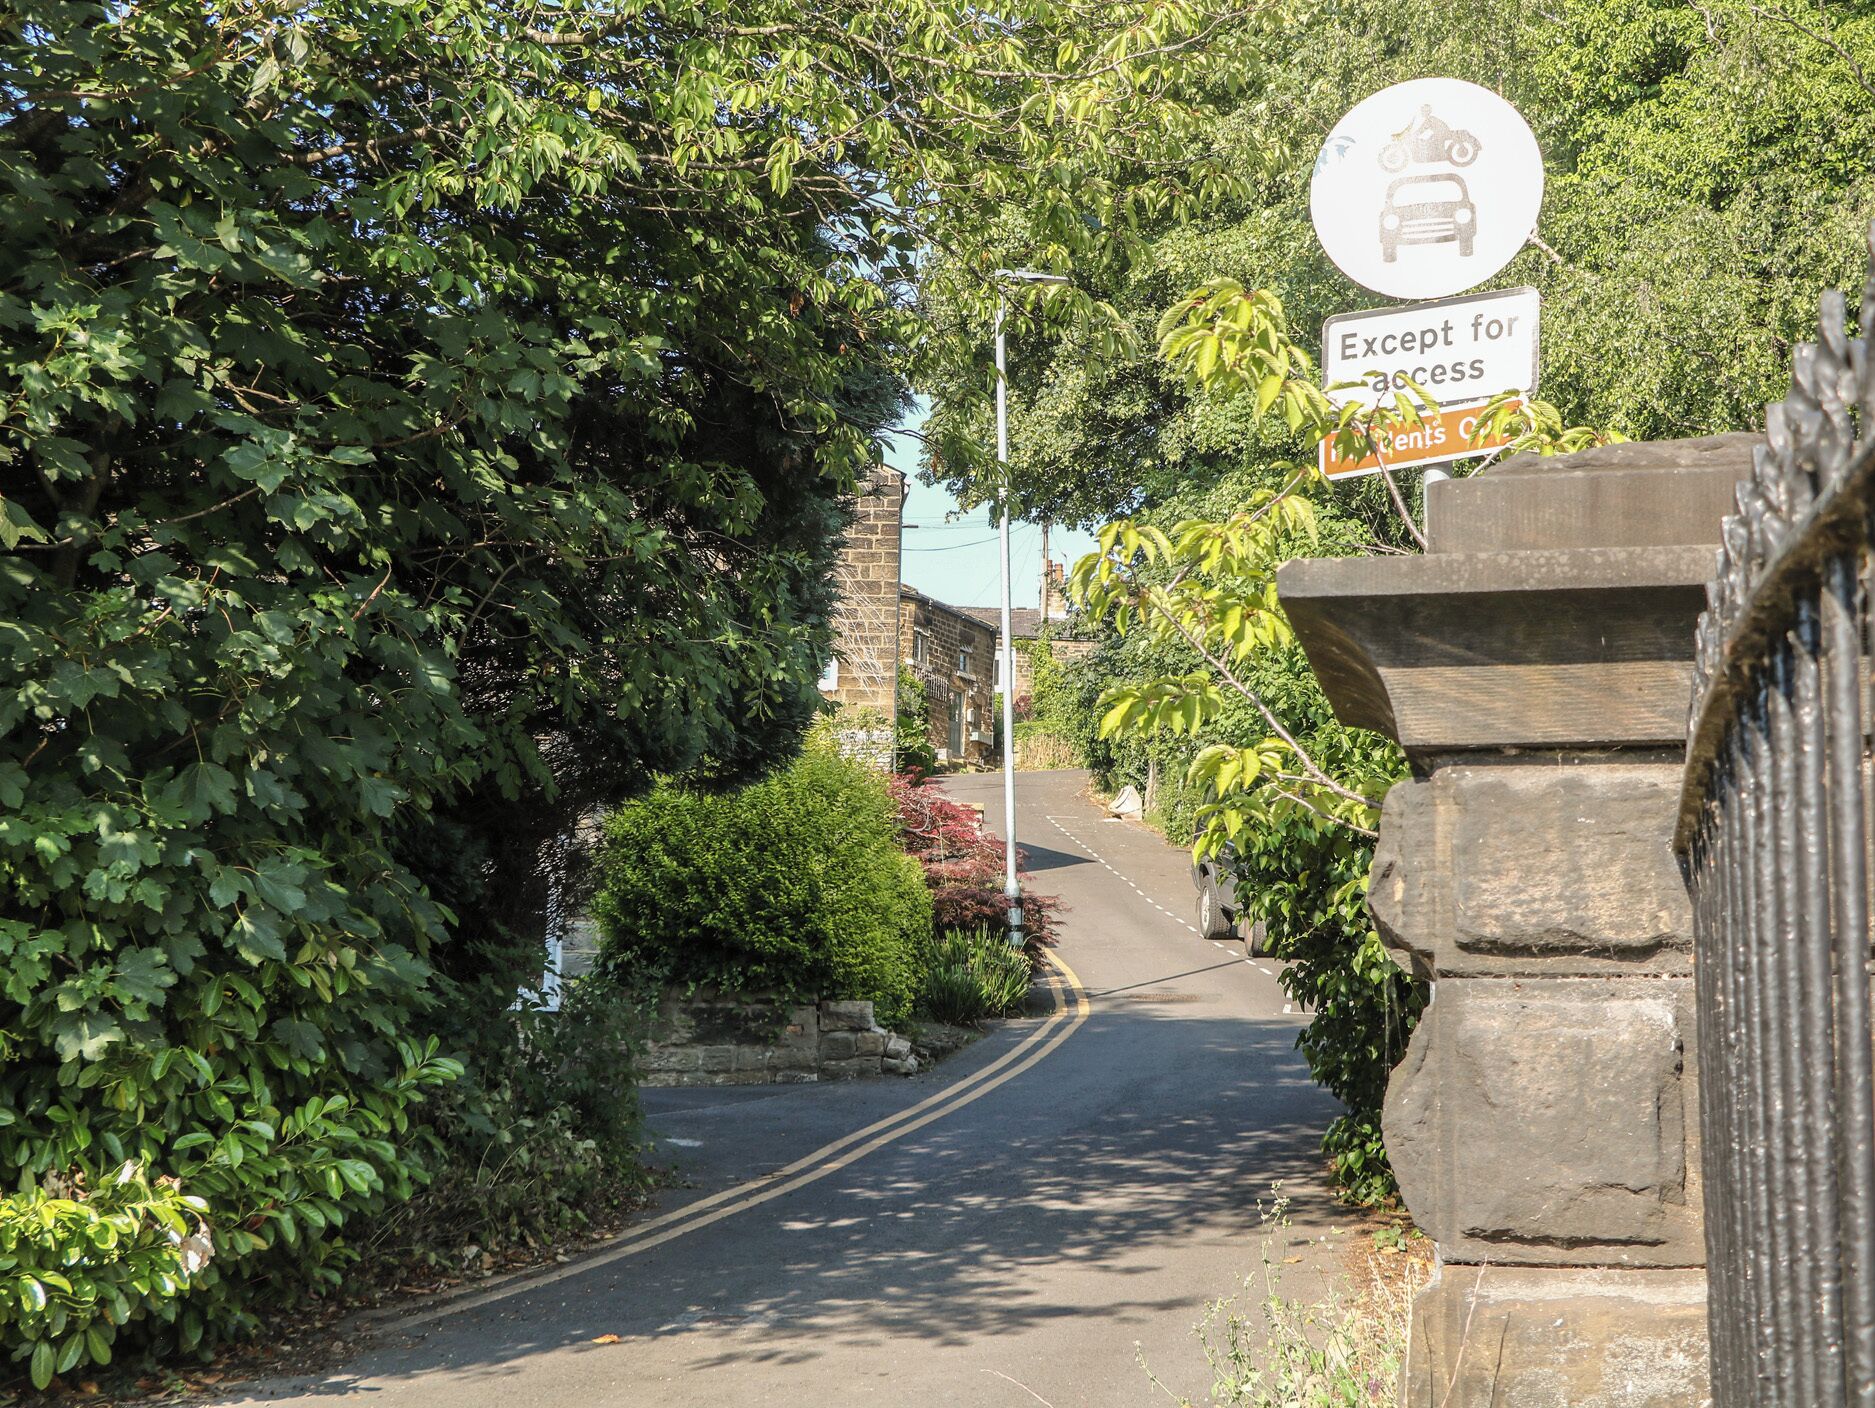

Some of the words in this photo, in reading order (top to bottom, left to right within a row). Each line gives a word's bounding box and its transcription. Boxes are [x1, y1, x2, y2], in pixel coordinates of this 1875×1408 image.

[1341, 320, 1453, 360] Except
[1471, 314, 1519, 342] for
[1372, 358, 1484, 393] access
